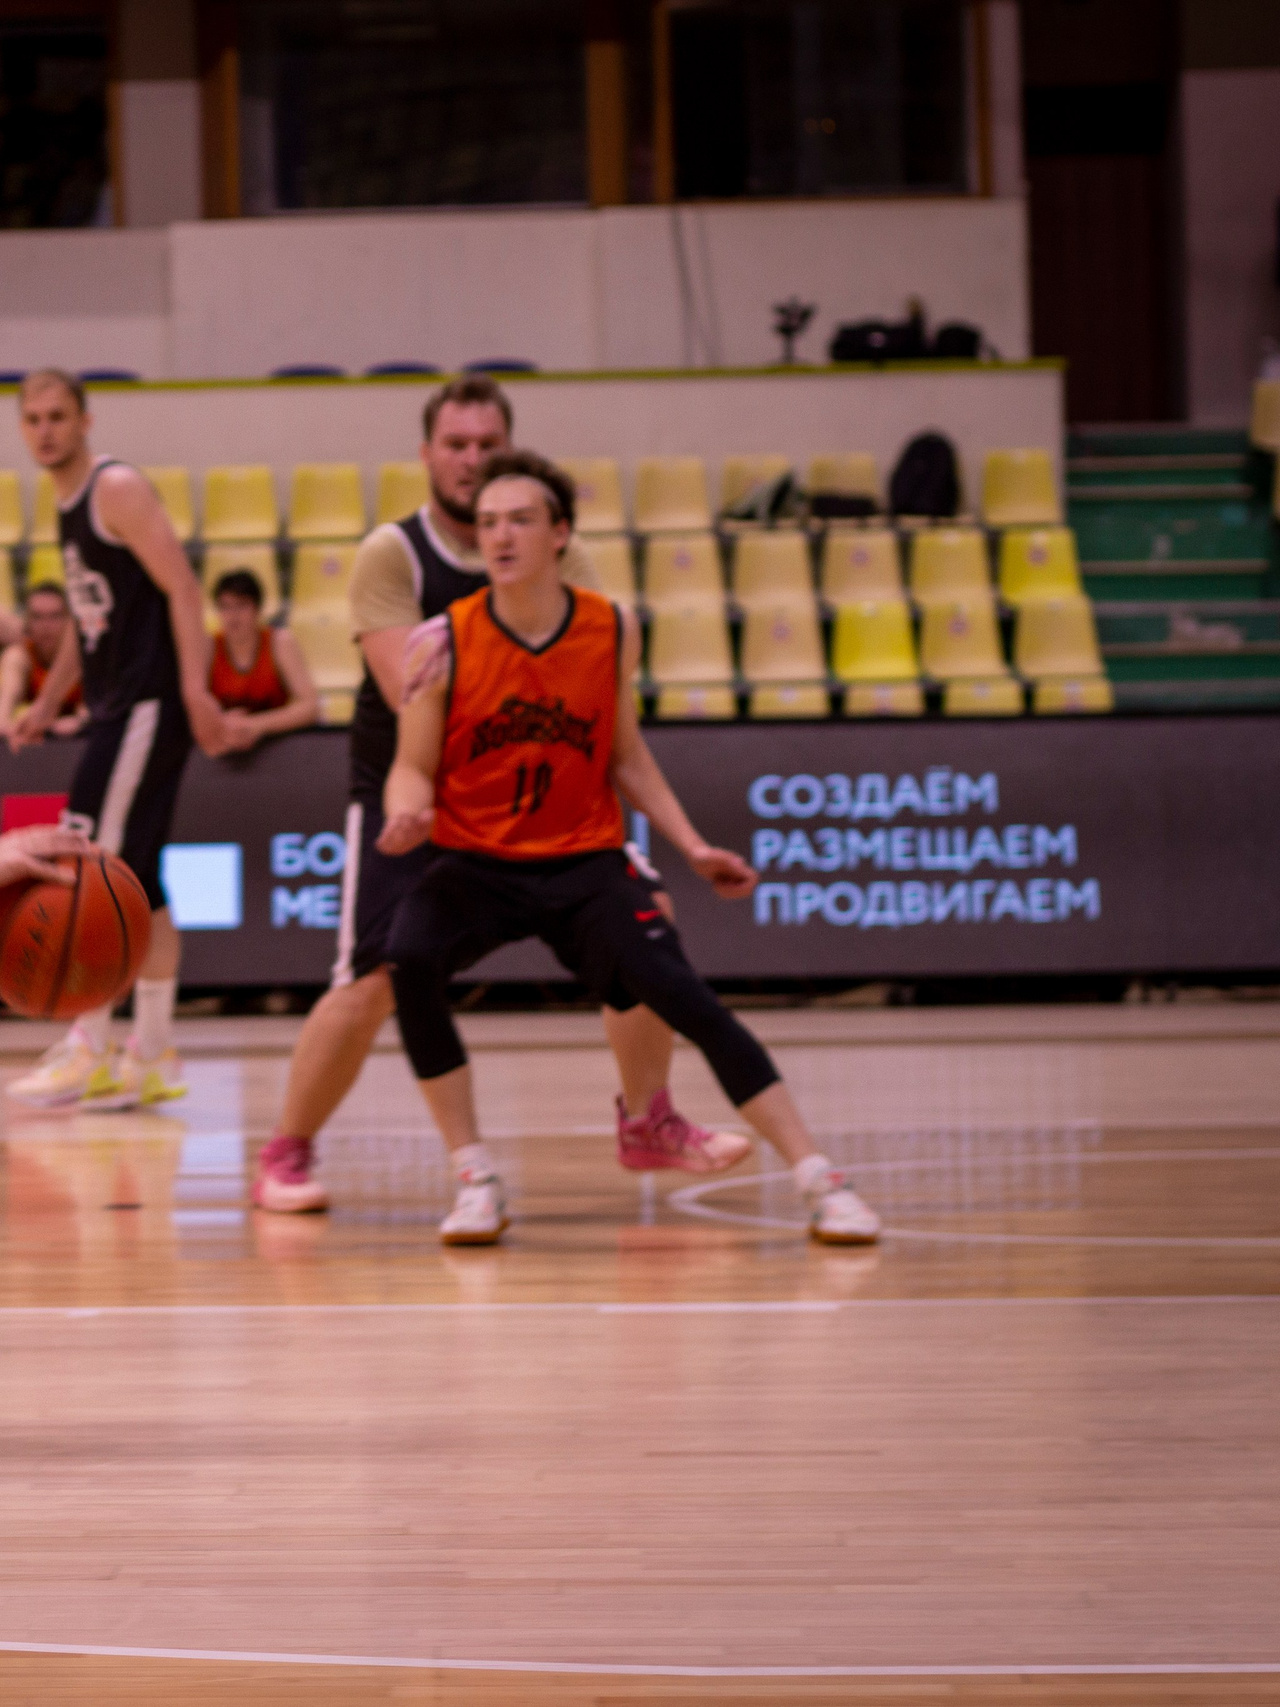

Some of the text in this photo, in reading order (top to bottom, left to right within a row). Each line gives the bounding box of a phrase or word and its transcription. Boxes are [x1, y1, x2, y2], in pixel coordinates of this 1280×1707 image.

[747, 766, 999, 821] СОЗДАЁМ
[751, 824, 1078, 873] РАЗМЕЩАЕМ
[754, 878, 1101, 929] ПРОДВИГАЕМ
